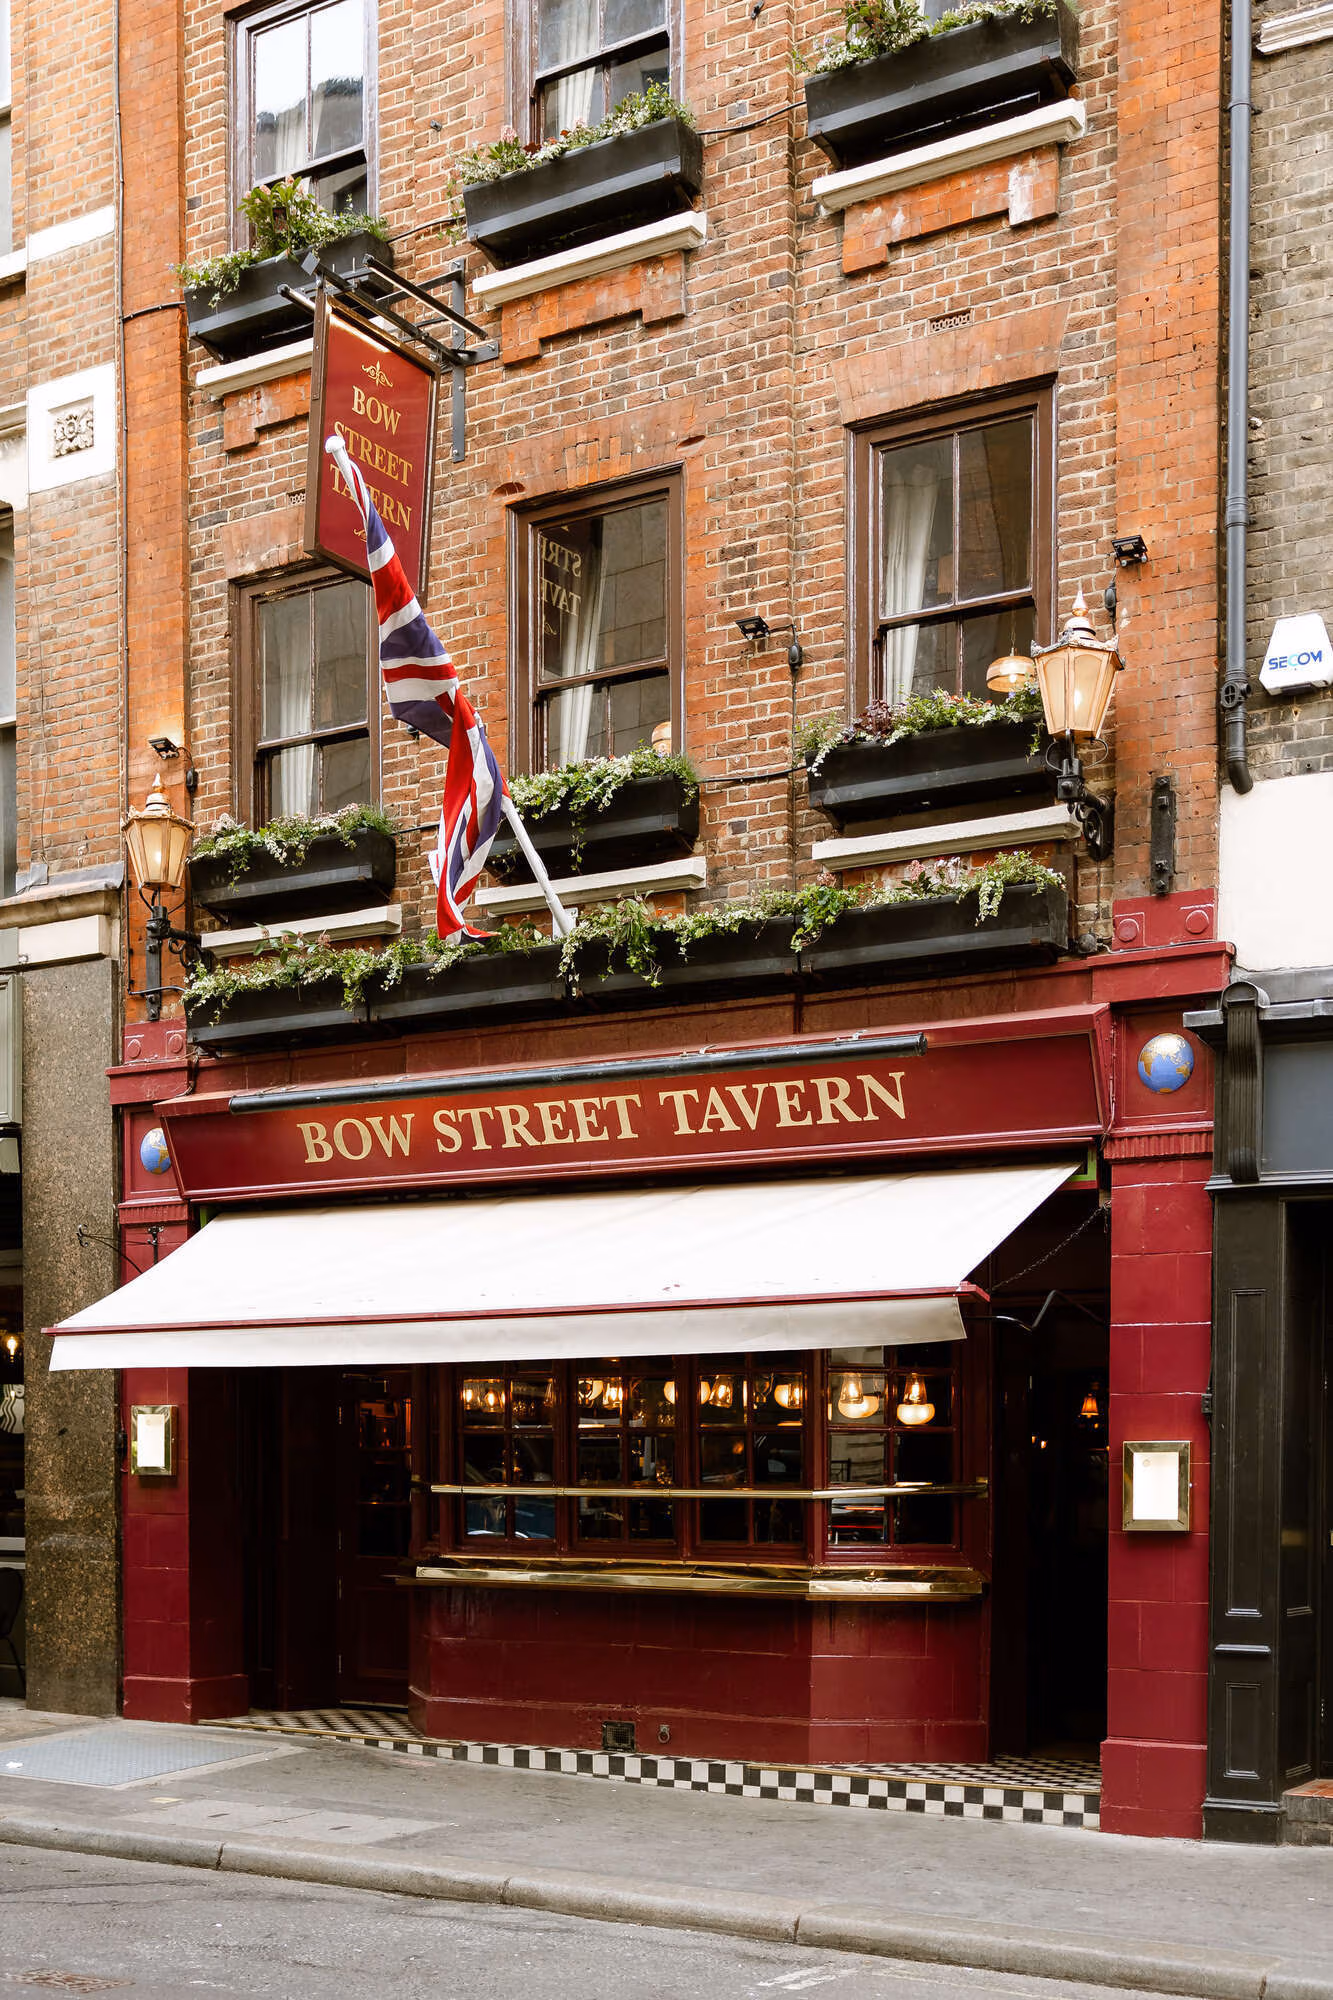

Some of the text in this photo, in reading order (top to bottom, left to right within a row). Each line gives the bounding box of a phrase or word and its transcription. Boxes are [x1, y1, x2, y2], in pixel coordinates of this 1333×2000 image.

[352, 385, 401, 436] BOW
[334, 421, 413, 487] STREET
[330, 463, 412, 532] TAERN
[1268, 650, 1323, 671] SECOM
[297, 1071, 906, 1164] BOW STREET TAVERN
